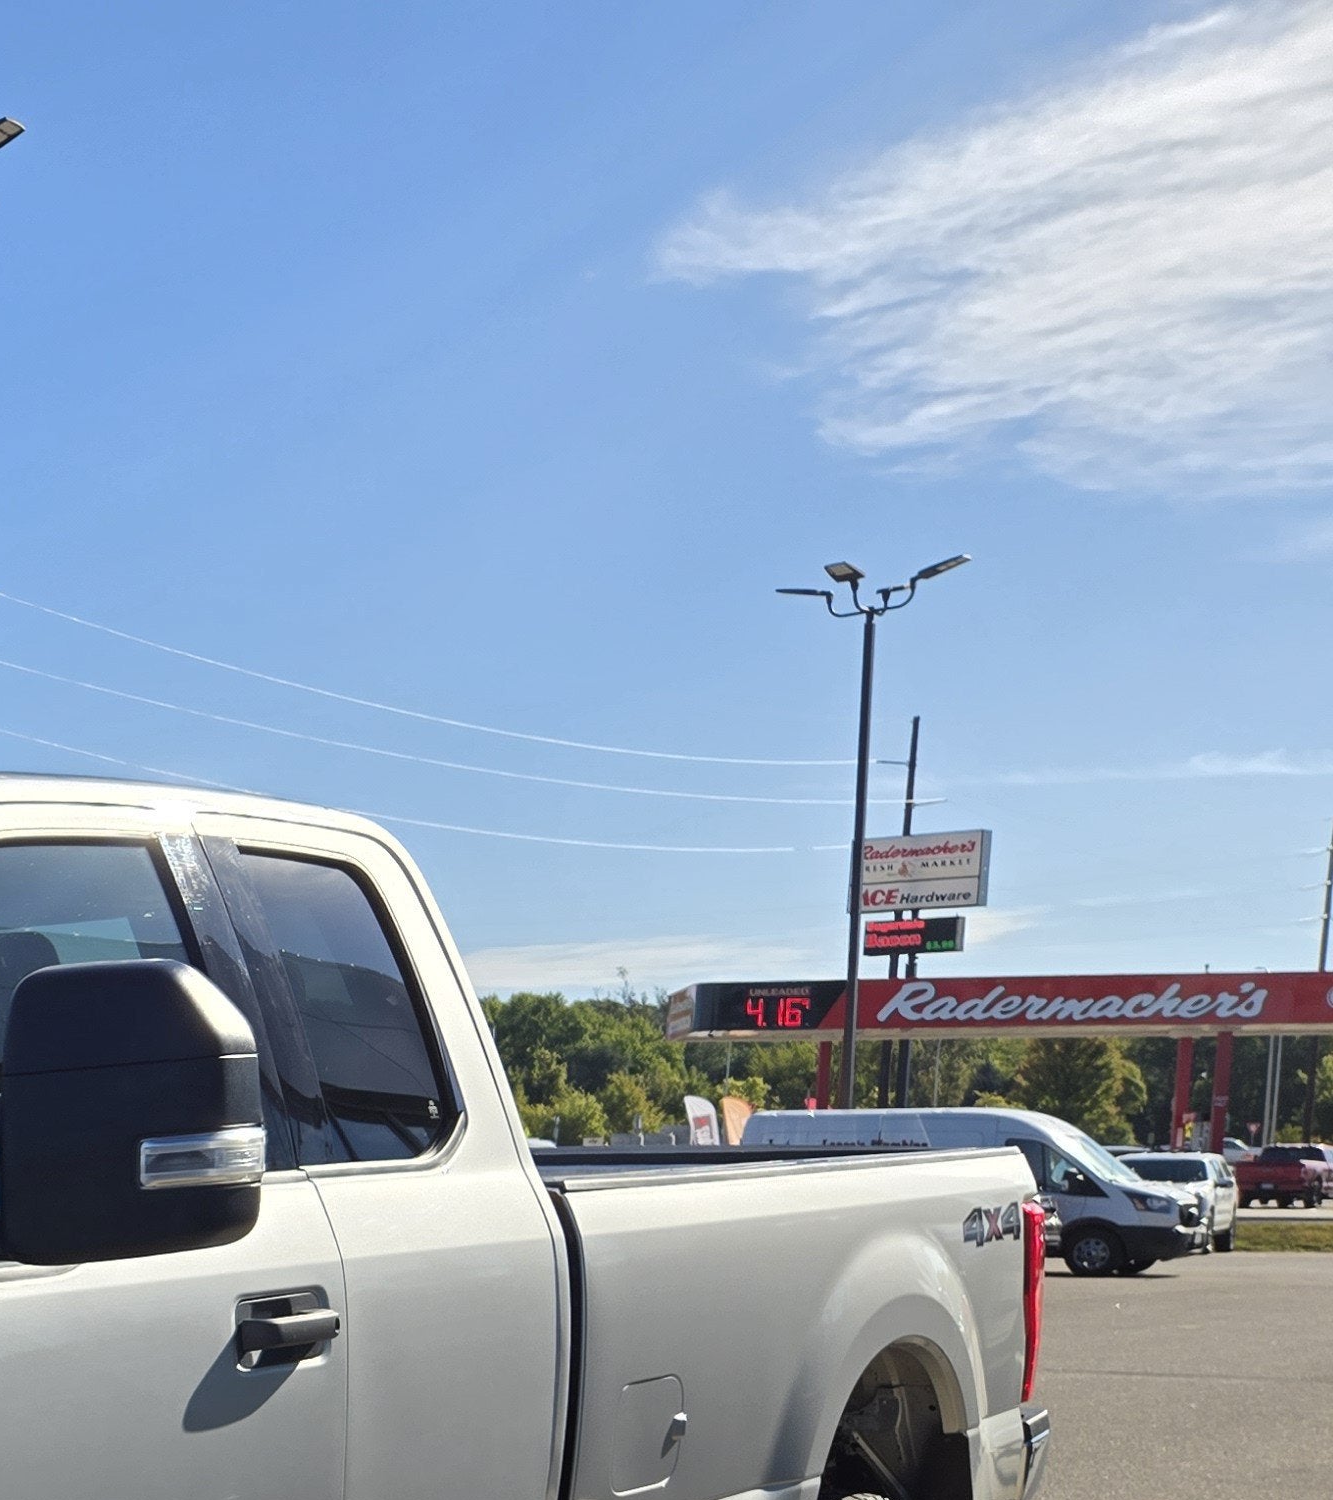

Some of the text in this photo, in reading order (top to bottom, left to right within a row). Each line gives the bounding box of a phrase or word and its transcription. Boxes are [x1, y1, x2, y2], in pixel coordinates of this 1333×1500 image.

[921, 859, 971, 868] MARKET
[899, 892, 972, 905] Hardware
[749, 988, 810, 996] UNLEADED
[876, 981, 1269, 1022] Radermacher's
